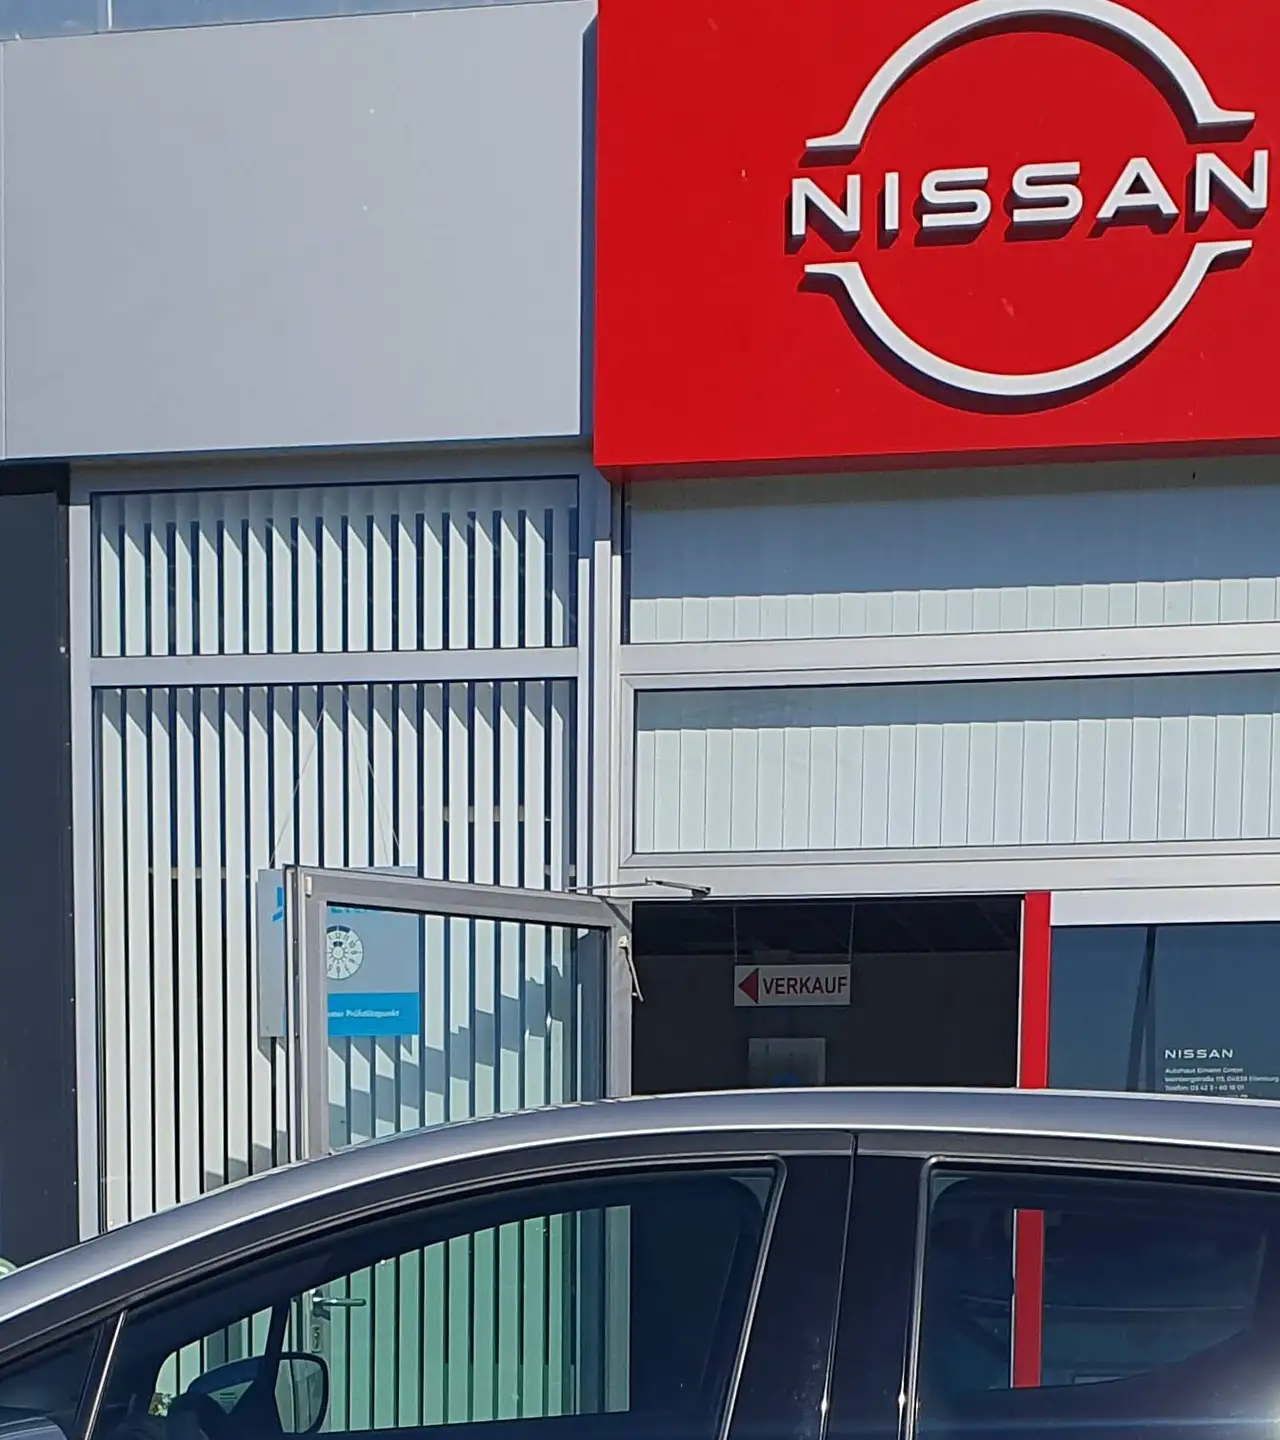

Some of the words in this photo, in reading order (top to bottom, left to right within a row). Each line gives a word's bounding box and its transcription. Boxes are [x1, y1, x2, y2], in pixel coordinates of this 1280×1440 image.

[790, 149, 1270, 238] NISSAN
[762, 976, 848, 996] VERKAUF
[1164, 1048, 1234, 1060] NISSAN
